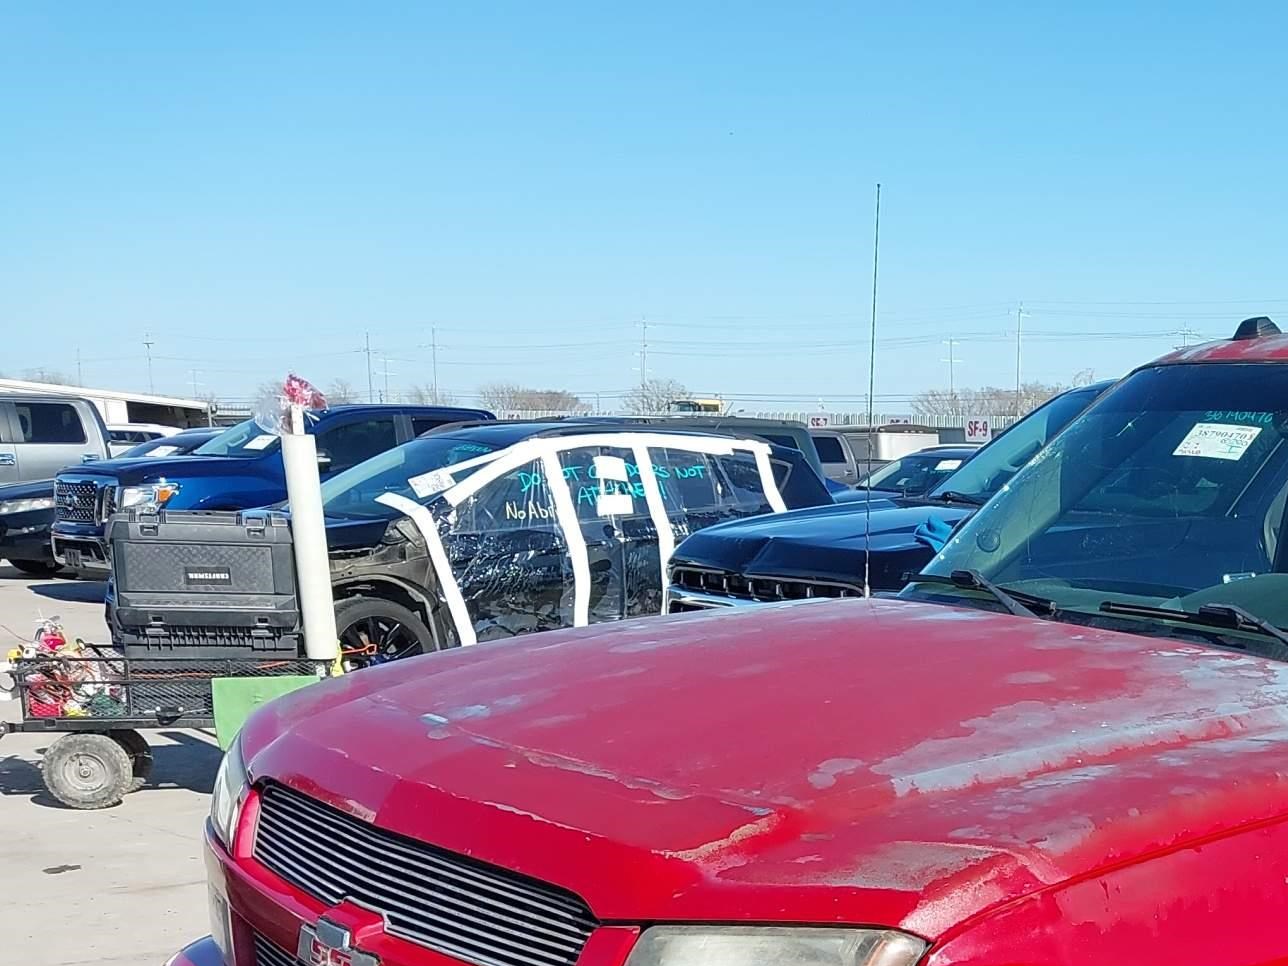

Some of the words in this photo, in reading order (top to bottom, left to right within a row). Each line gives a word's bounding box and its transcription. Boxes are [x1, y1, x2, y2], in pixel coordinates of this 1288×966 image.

[967, 421, 988, 437] SF-9
[518, 472, 541, 492] DO
[561, 466, 583, 482] OT
[674, 466, 706, 480] NOT
[506, 500, 526, 520] No
